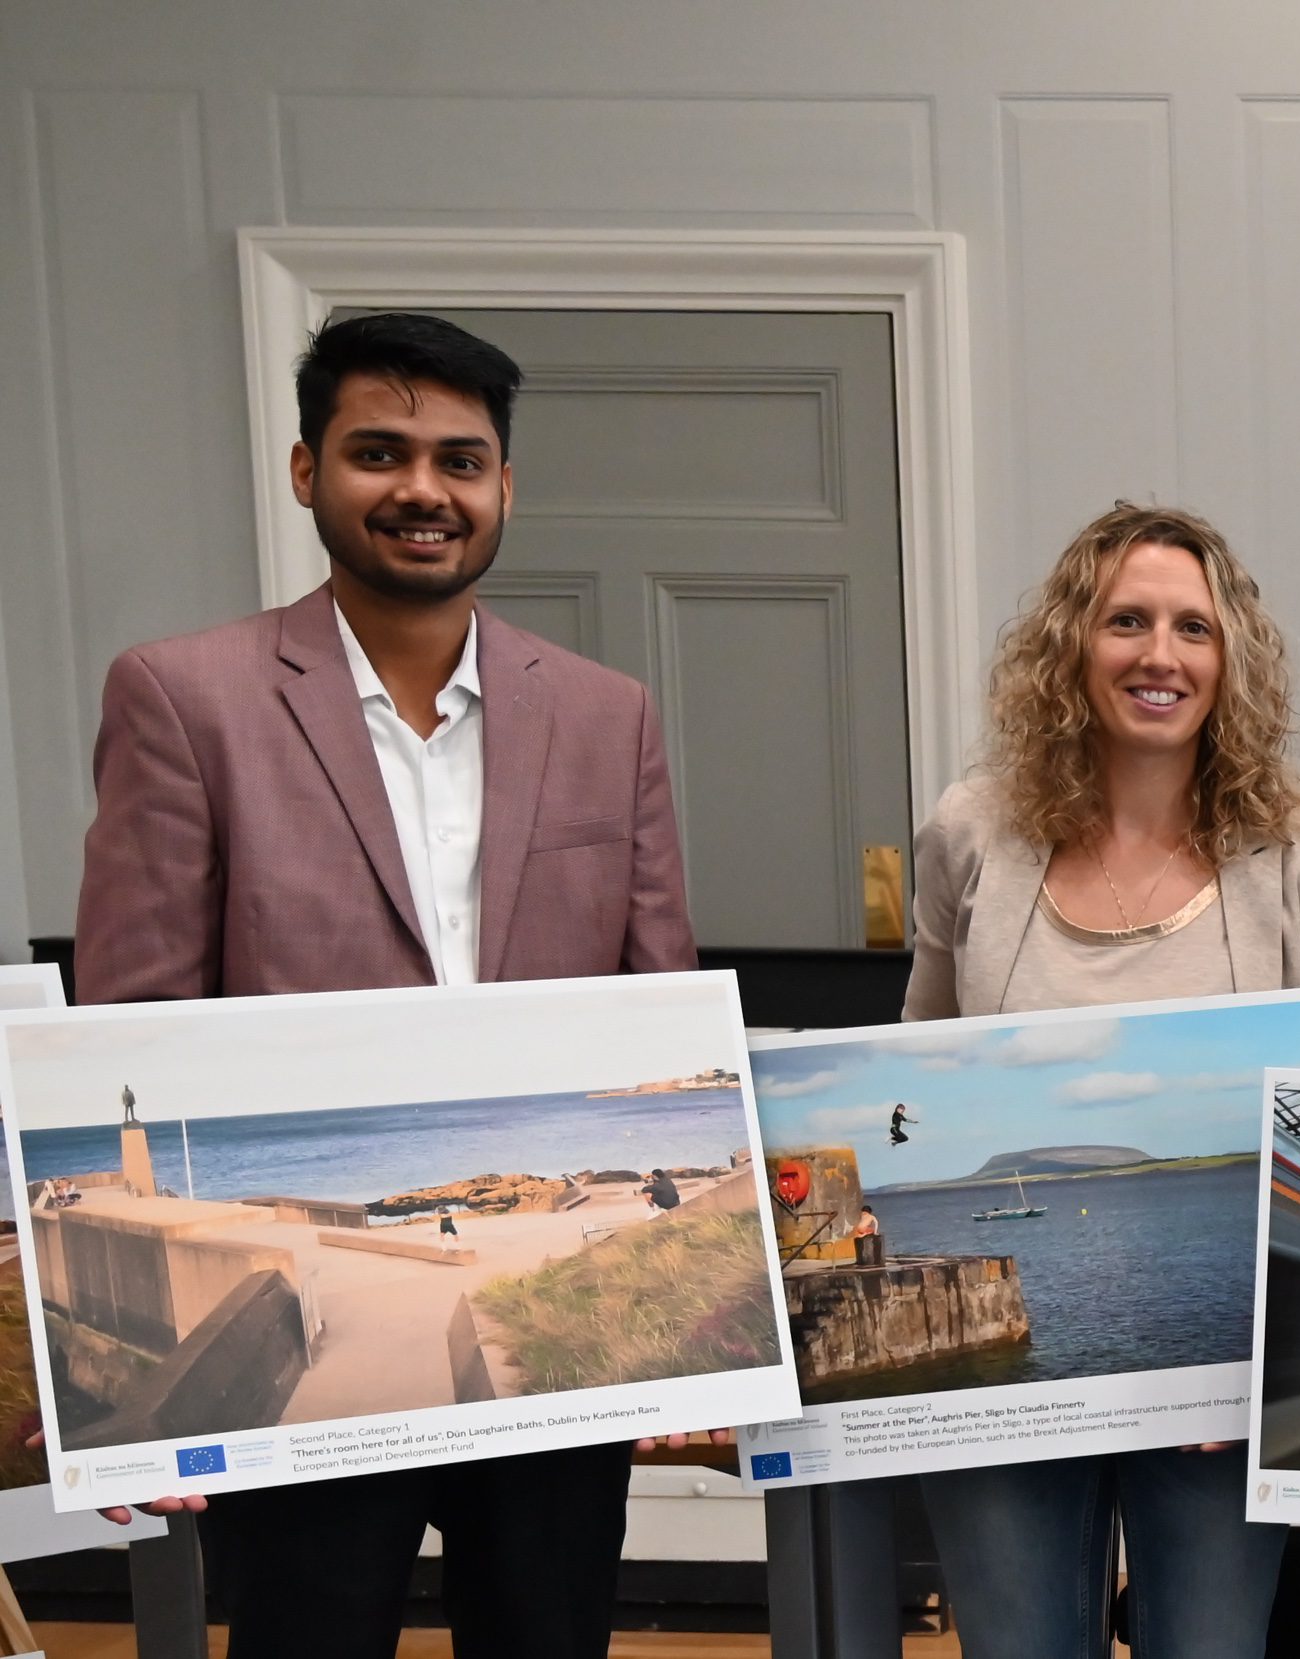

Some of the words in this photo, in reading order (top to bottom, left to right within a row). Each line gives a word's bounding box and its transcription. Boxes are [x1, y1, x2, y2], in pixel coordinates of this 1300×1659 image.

[840, 1410, 859, 1419] First
[861, 1409, 885, 1417] Place,
[887, 1405, 924, 1414] Category
[931, 1413, 962, 1422] Aughris
[964, 1411, 983, 1419] Pier,
[985, 1409, 1004, 1417] Sligo
[1006, 1407, 1016, 1415] by
[1018, 1404, 1049, 1413] Claudia
[1051, 1401, 1085, 1410] Finnerty
[289, 1432, 325, 1445] Second
[328, 1431, 355, 1440] Place,
[358, 1425, 401, 1436] Category
[404, 1422, 409, 1431] 1
[333, 1444, 359, 1453] room
[361, 1441, 383, 1450] here
[386, 1438, 399, 1446] for
[402, 1436, 413, 1444] all
[415, 1434, 424, 1443] of
[468, 1424, 514, 1436] Laoghaire
[516, 1420, 545, 1430] Baths,
[547, 1416, 577, 1426] Dublin
[580, 1414, 590, 1422] by
[593, 1410, 635, 1420] Kartikeya
[638, 1406, 660, 1414] Rana
[293, 1460, 339, 1472] European
[341, 1453, 382, 1466] Regional
[385, 1445, 448, 1460] Development
[450, 1439, 474, 1452] Fund
